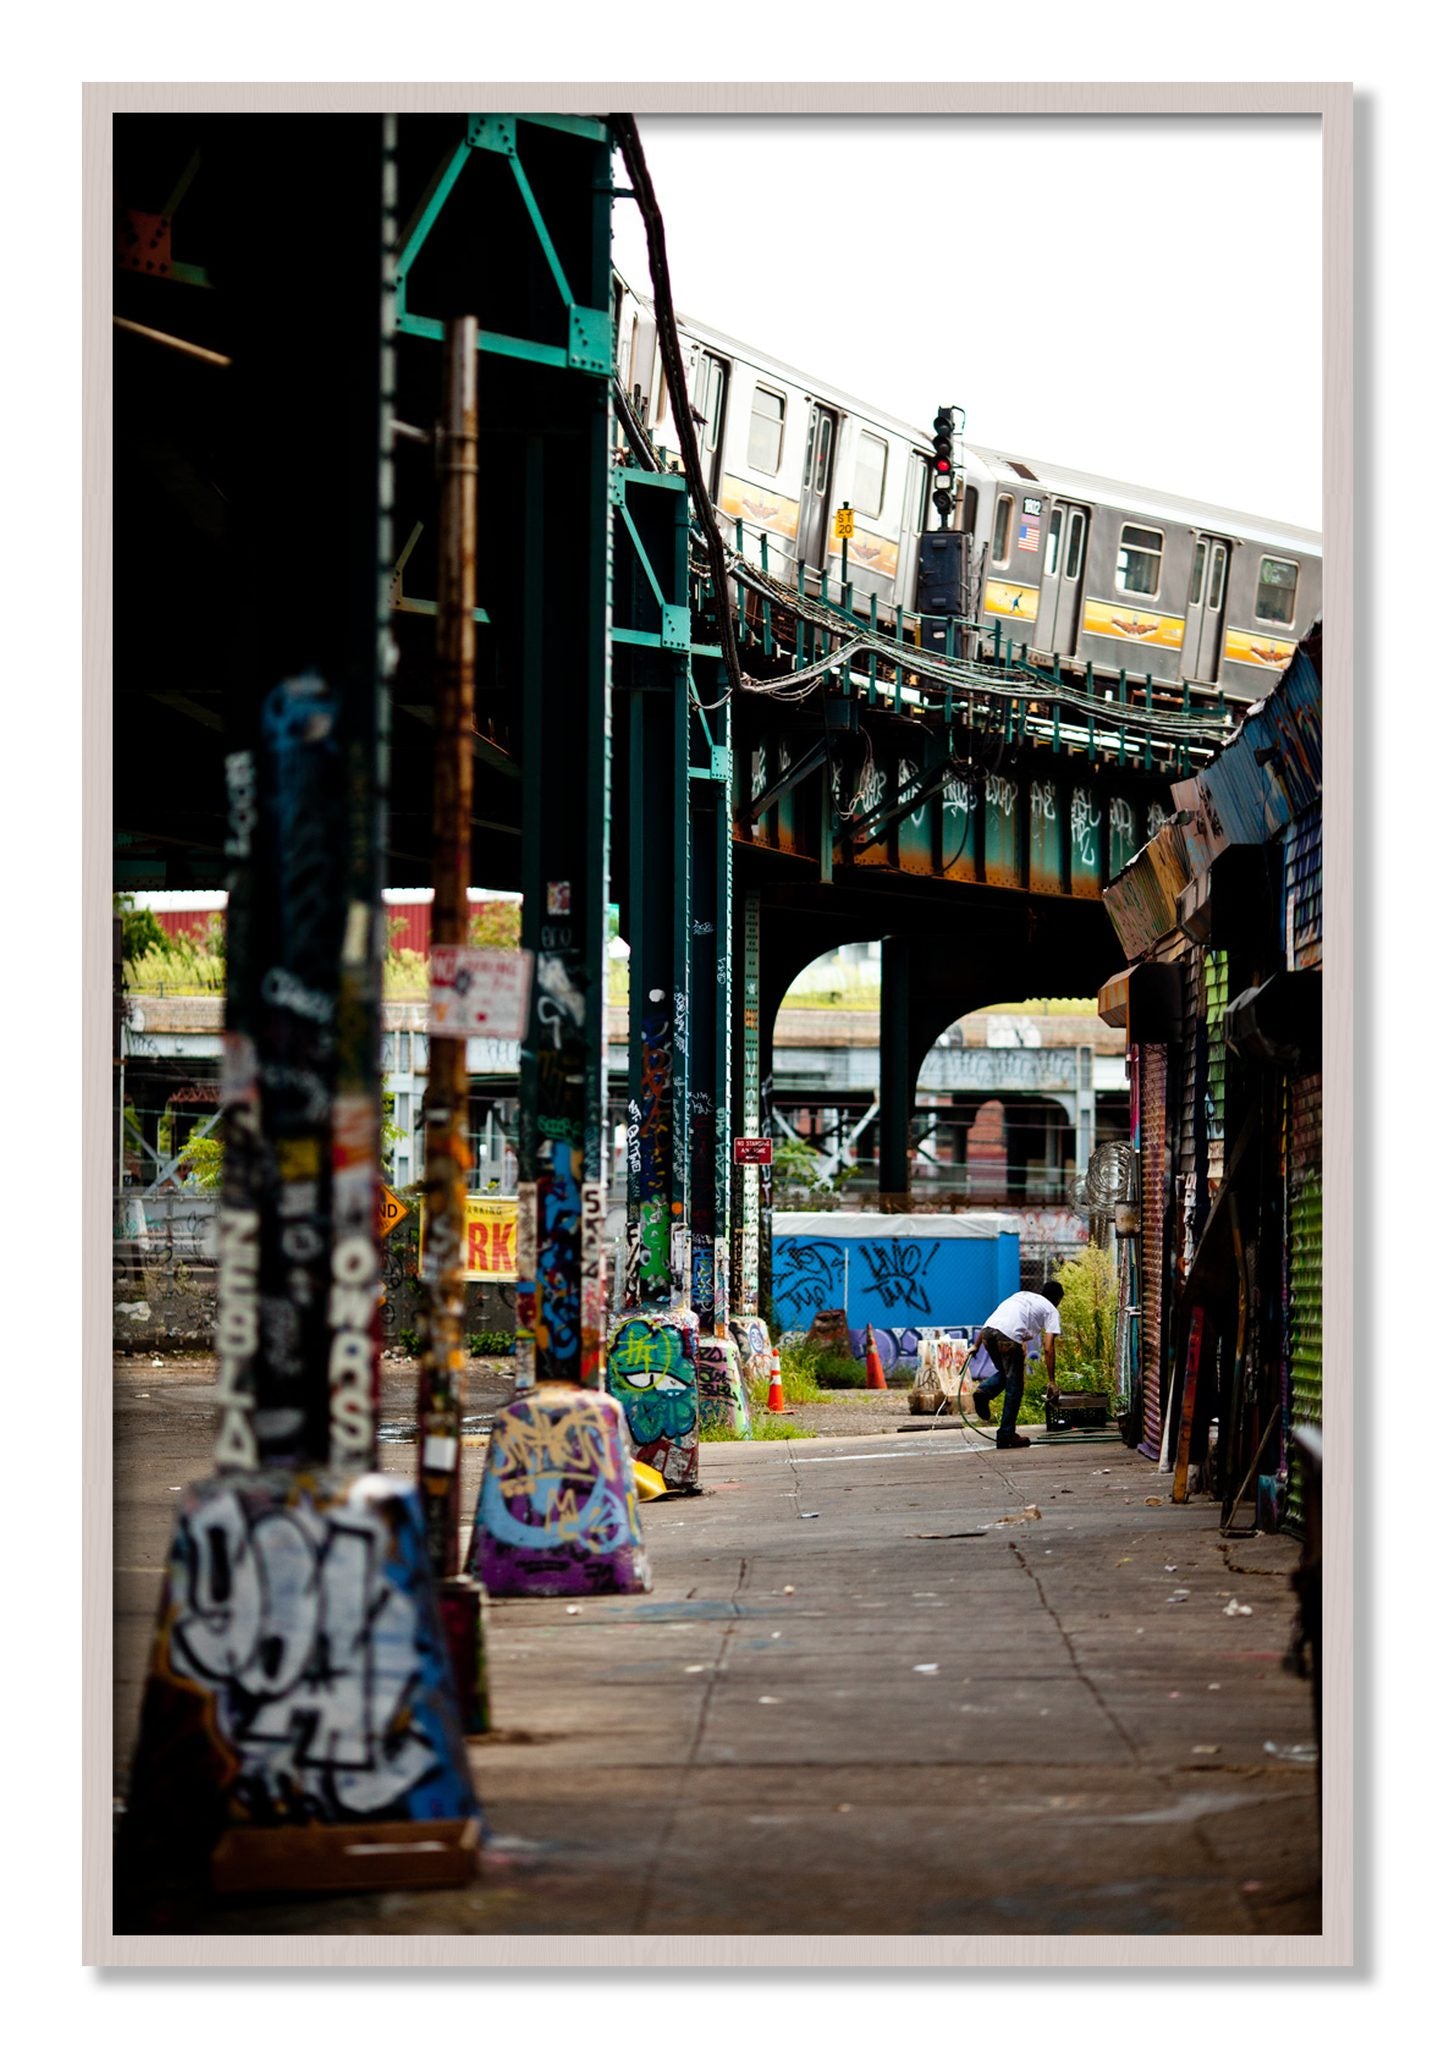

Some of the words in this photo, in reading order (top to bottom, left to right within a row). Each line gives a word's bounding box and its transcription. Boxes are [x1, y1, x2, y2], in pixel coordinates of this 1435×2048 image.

[838, 513, 851, 524] ST
[838, 524, 852, 534] 20
[378, 1203, 398, 1219] ND
[468, 1222, 514, 1271] RK
